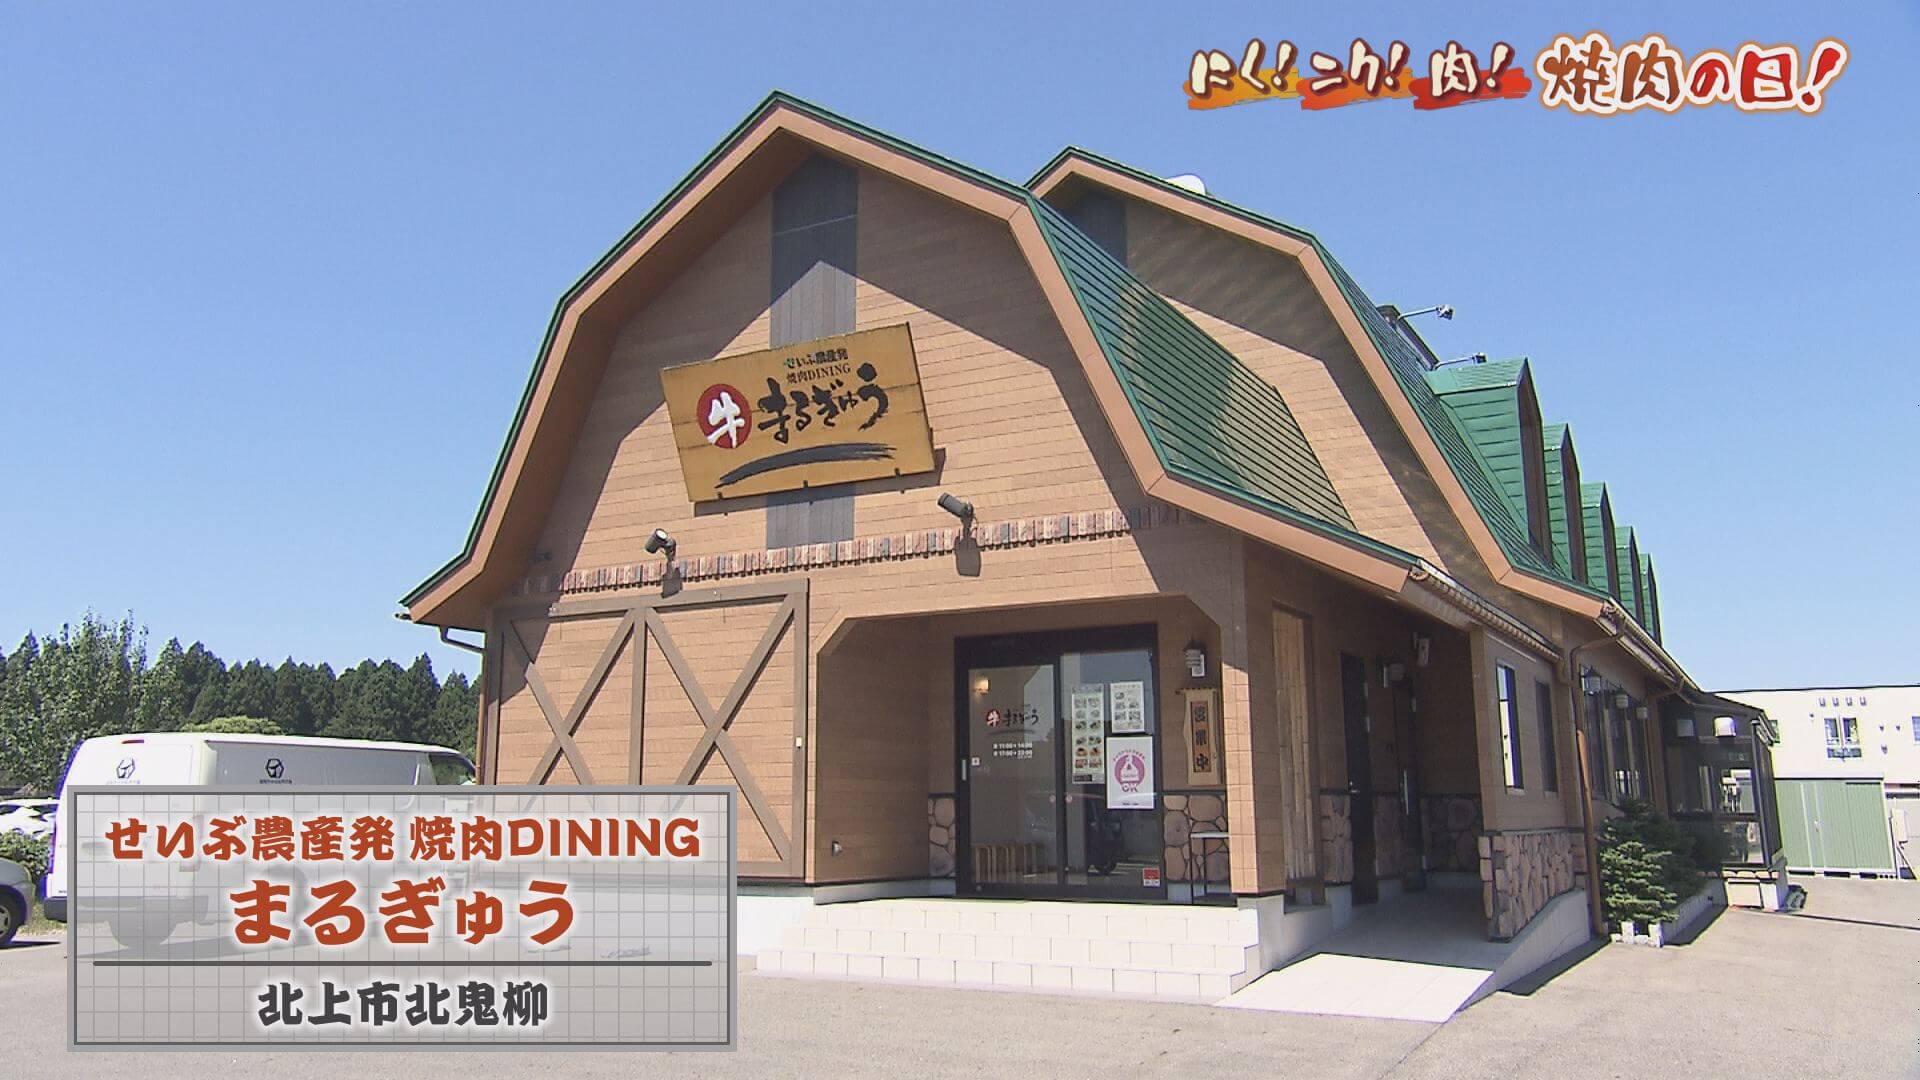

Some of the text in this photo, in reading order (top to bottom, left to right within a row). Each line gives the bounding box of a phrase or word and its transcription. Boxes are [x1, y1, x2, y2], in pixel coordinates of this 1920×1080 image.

[707, 362, 889, 448] 牛 まるぎゅう
